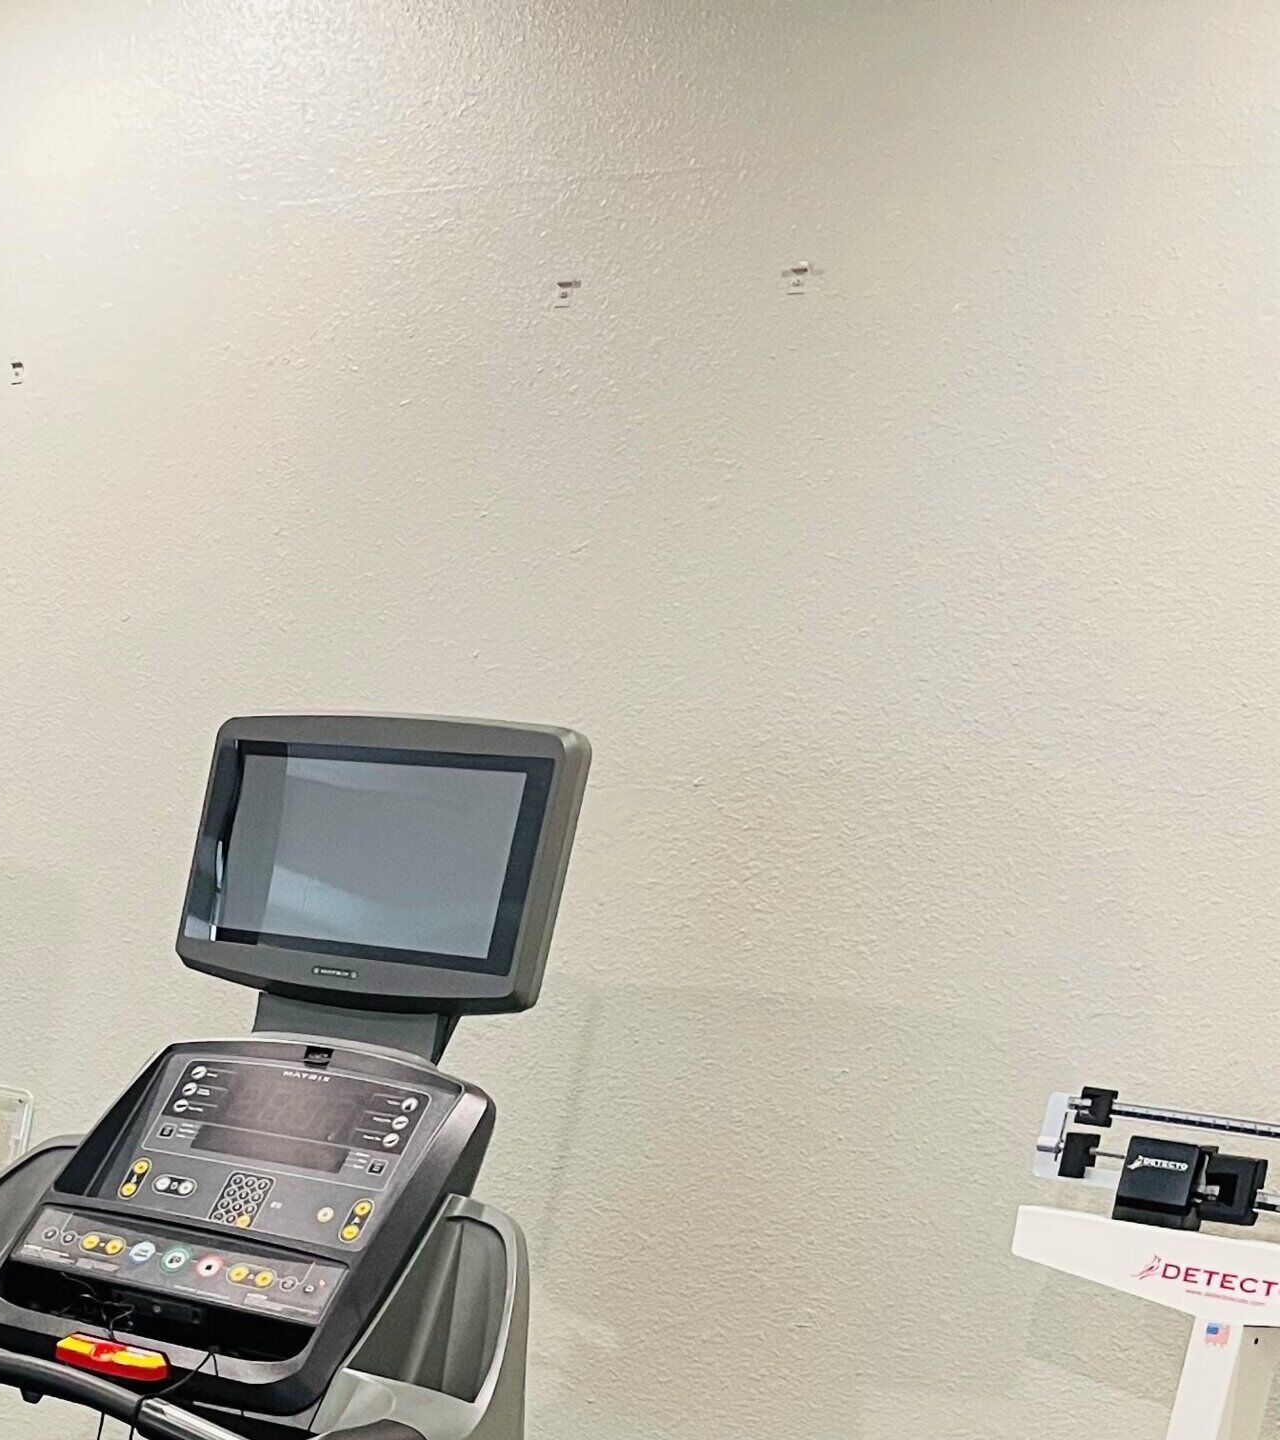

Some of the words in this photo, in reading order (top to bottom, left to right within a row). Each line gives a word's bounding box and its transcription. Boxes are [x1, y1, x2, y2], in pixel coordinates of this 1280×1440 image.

[282, 1070, 331, 1083] MATRIX
[1143, 1157, 1189, 1171] DETECTO
[1161, 1263, 1280, 1297] DETECT
